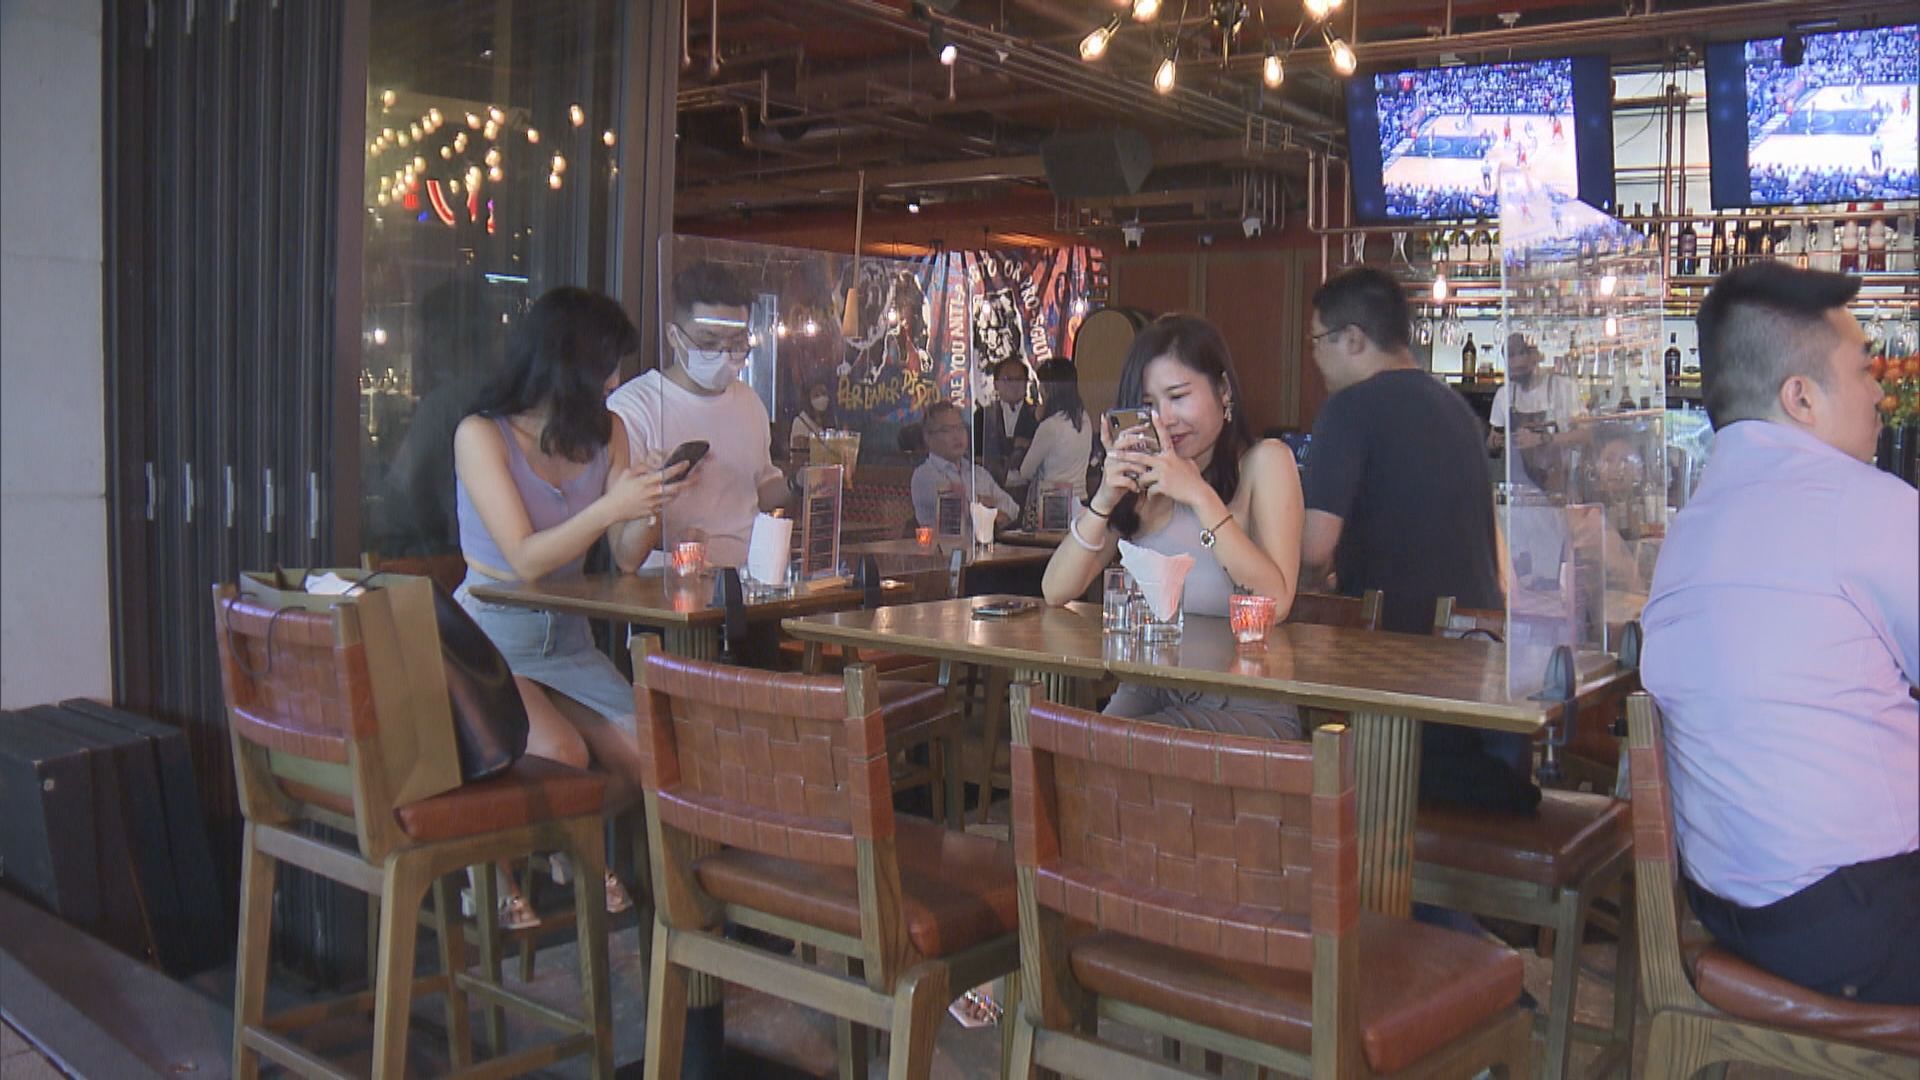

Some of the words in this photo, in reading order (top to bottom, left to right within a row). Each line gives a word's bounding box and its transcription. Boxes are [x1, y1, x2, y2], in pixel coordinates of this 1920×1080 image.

[1003, 259, 1022, 281] OR
[949, 340, 966, 375] YOU
[949, 376, 966, 409] ARE
